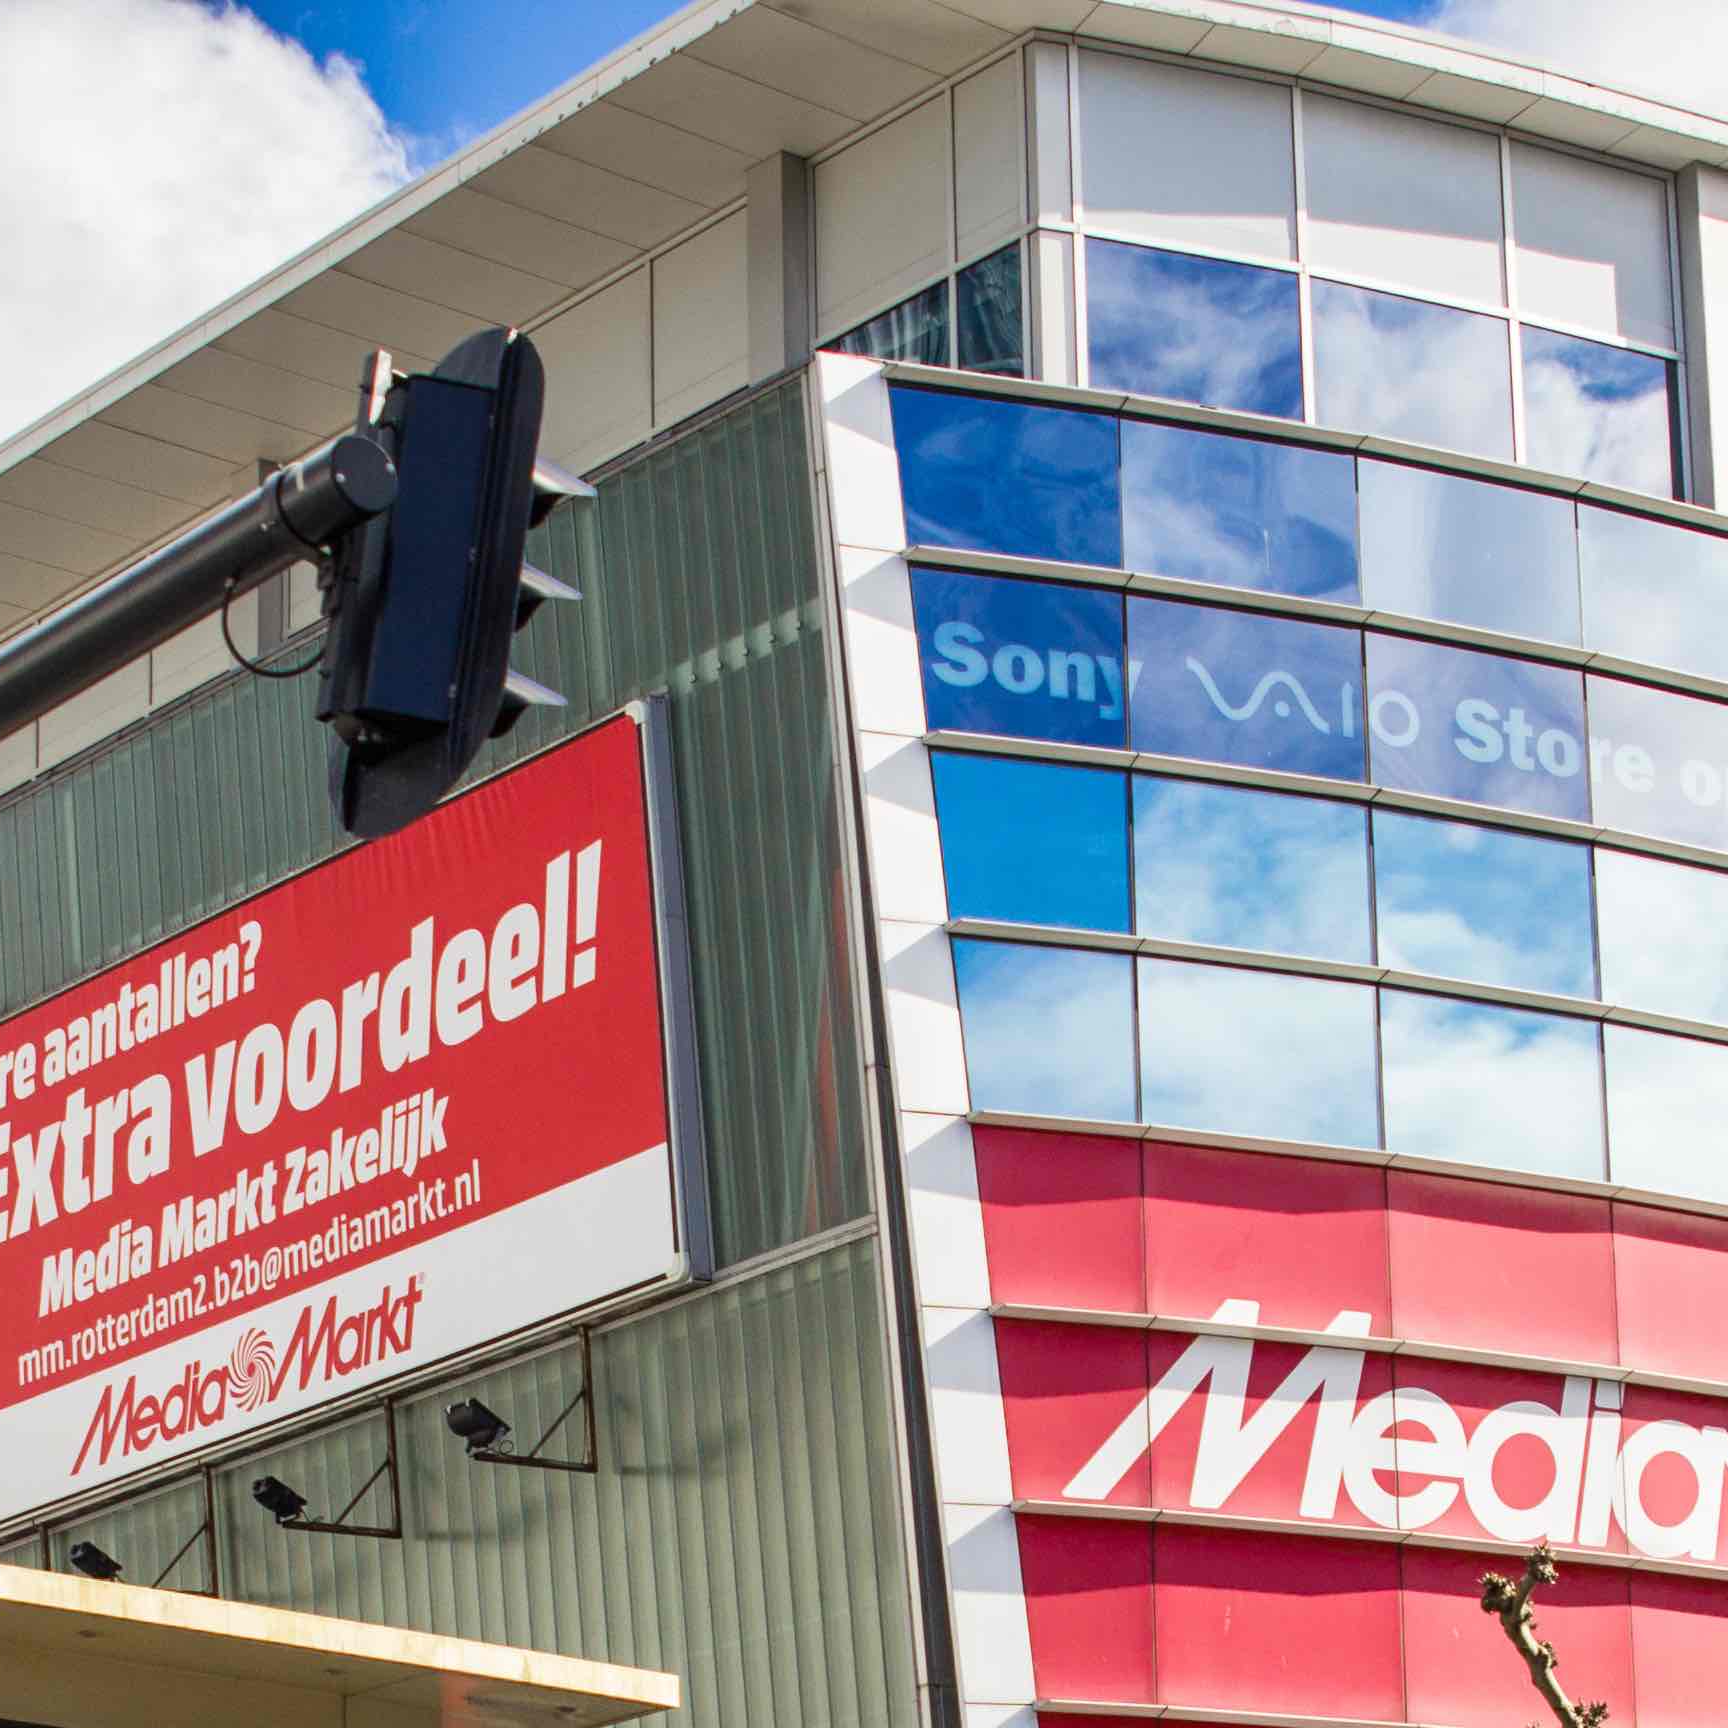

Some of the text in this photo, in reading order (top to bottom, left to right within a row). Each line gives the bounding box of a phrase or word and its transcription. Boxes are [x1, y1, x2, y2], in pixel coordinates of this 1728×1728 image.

[931, 620, 1143, 722] Sony
[1185, 655, 1420, 748] VAIO
[1454, 699, 1656, 794] Store
[42, 920, 262, 1083] aantallen?
[183, 839, 603, 1159] voordeel!
[17, 1158, 481, 1386] mm.rotterdam2.b2b@mediamarkt.nl
[38, 1087, 450, 1318] Media Markt Zakelijk
[69, 1272, 422, 1476] Media Markt
